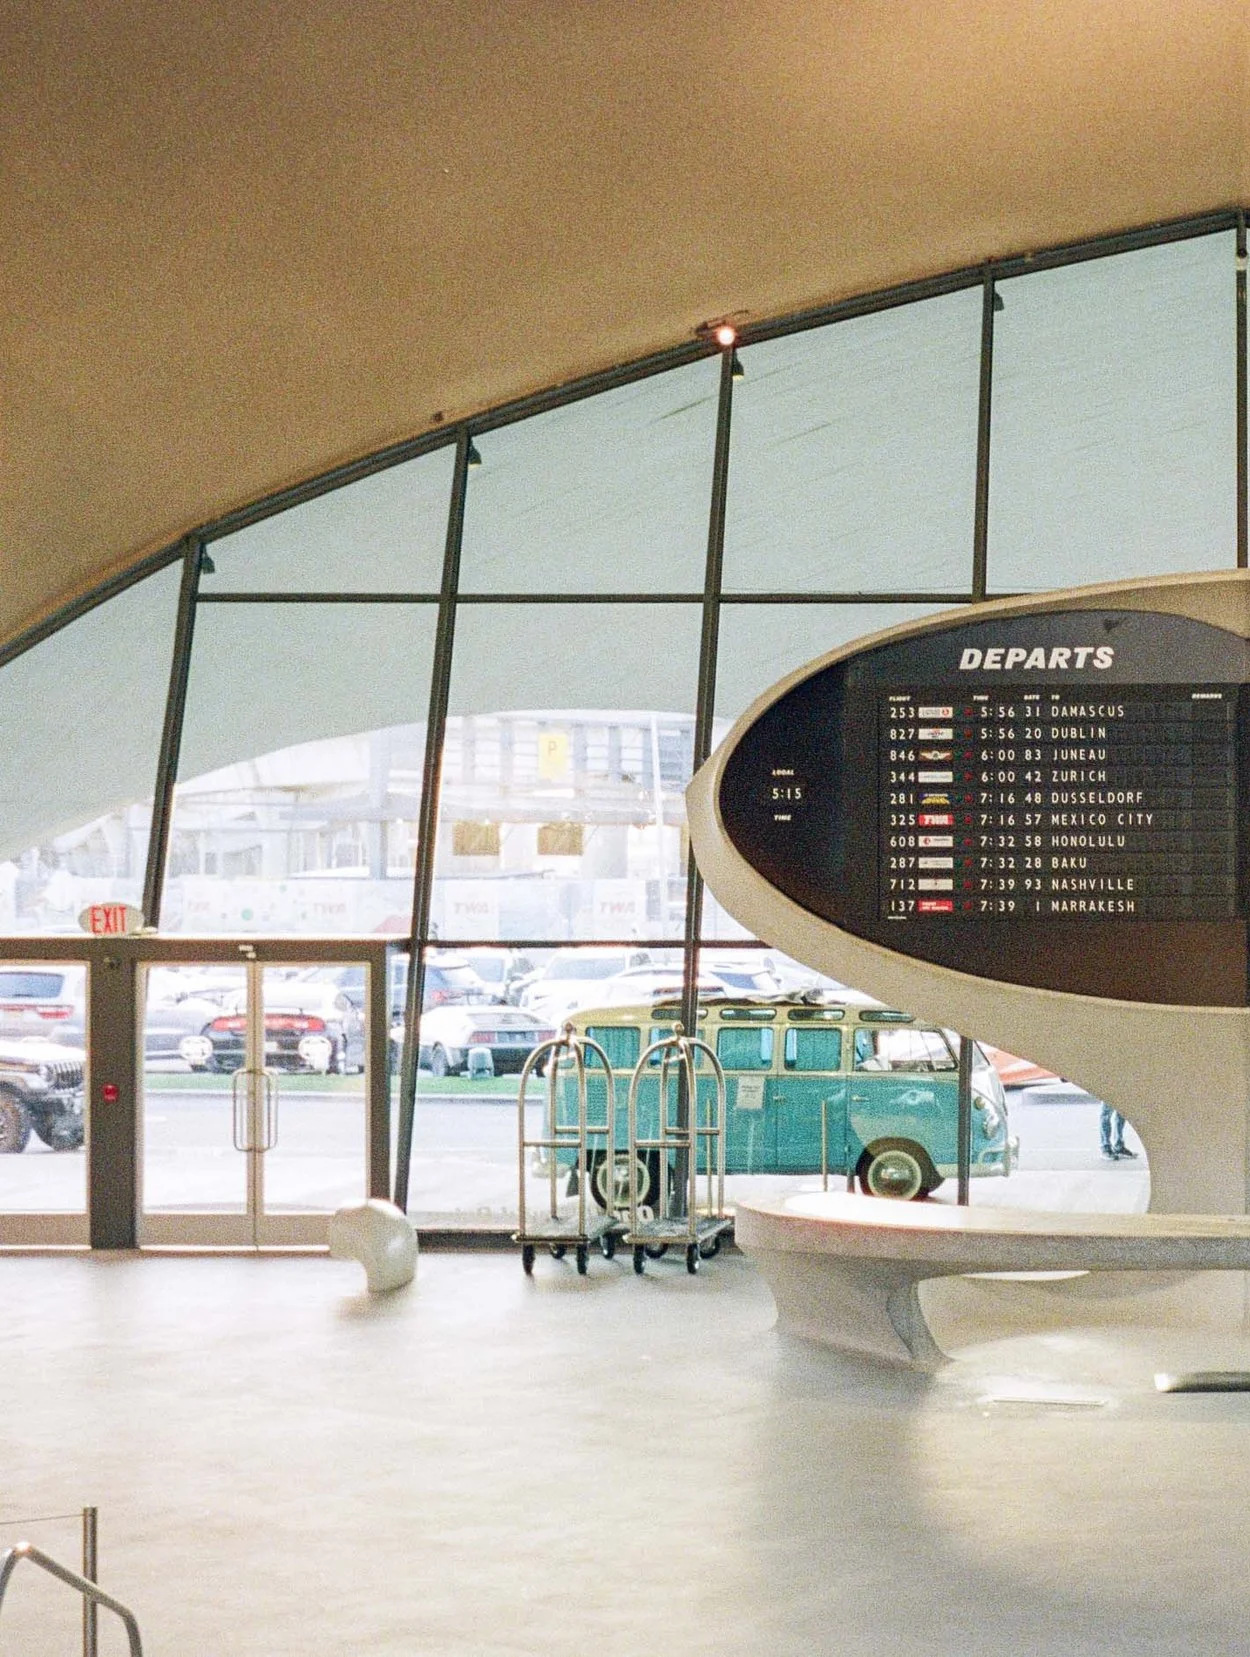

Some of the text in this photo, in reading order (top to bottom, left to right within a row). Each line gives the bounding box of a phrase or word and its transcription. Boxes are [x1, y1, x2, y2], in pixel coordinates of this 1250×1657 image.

[959, 646, 1115, 670] DEPARTS
[891, 707, 914, 718] 253
[981, 706, 1015, 718] 5:56
[1026, 706, 1039, 717] 31
[1052, 705, 1124, 717] DAMASCUS
[890, 729, 914, 739] 827
[981, 728, 1014, 739] 5:56
[1025, 728, 1041, 739] 20
[1052, 727, 1105, 738] DUBLIN
[890, 749, 1105, 761] 846 6:00 83 JUNEAU
[891, 771, 915, 783] 344
[982, 771, 1015, 782] 6:00
[1025, 771, 1041, 782] 42
[1053, 770, 1105, 782] ZURICH
[772, 788, 801, 799] 5:15
[891, 793, 913, 804] 281
[981, 793, 1014, 804] 7:16
[1025, 792, 1041, 803] 48
[1052, 792, 1142, 804] DUSSELDORF
[891, 814, 915, 825] 325
[981, 814, 1014, 825] 7:16
[1025, 814, 1041, 825] 57
[1052, 814, 1106, 825] MEXICO
[1118, 813, 1152, 825] CITY
[890, 836, 915, 847] 608
[981, 836, 1014, 847] 7:32
[1025, 835, 1041, 847] 58
[1052, 835, 1124, 847] HONOLULU
[891, 857, 915, 868] 287
[981, 857, 1014, 868] 7:32
[1025, 857, 1041, 868] 28
[1052, 857, 1086, 868] BAKU
[891, 879, 1133, 890] 712 7:39 93 NASHVILLE
[599, 901, 636, 914] TWA
[892, 901, 914, 911] 137
[981, 900, 1015, 911] 7:39
[1052, 900, 1134, 912] MARRAKESH
[90, 906, 126, 933] EXIT
